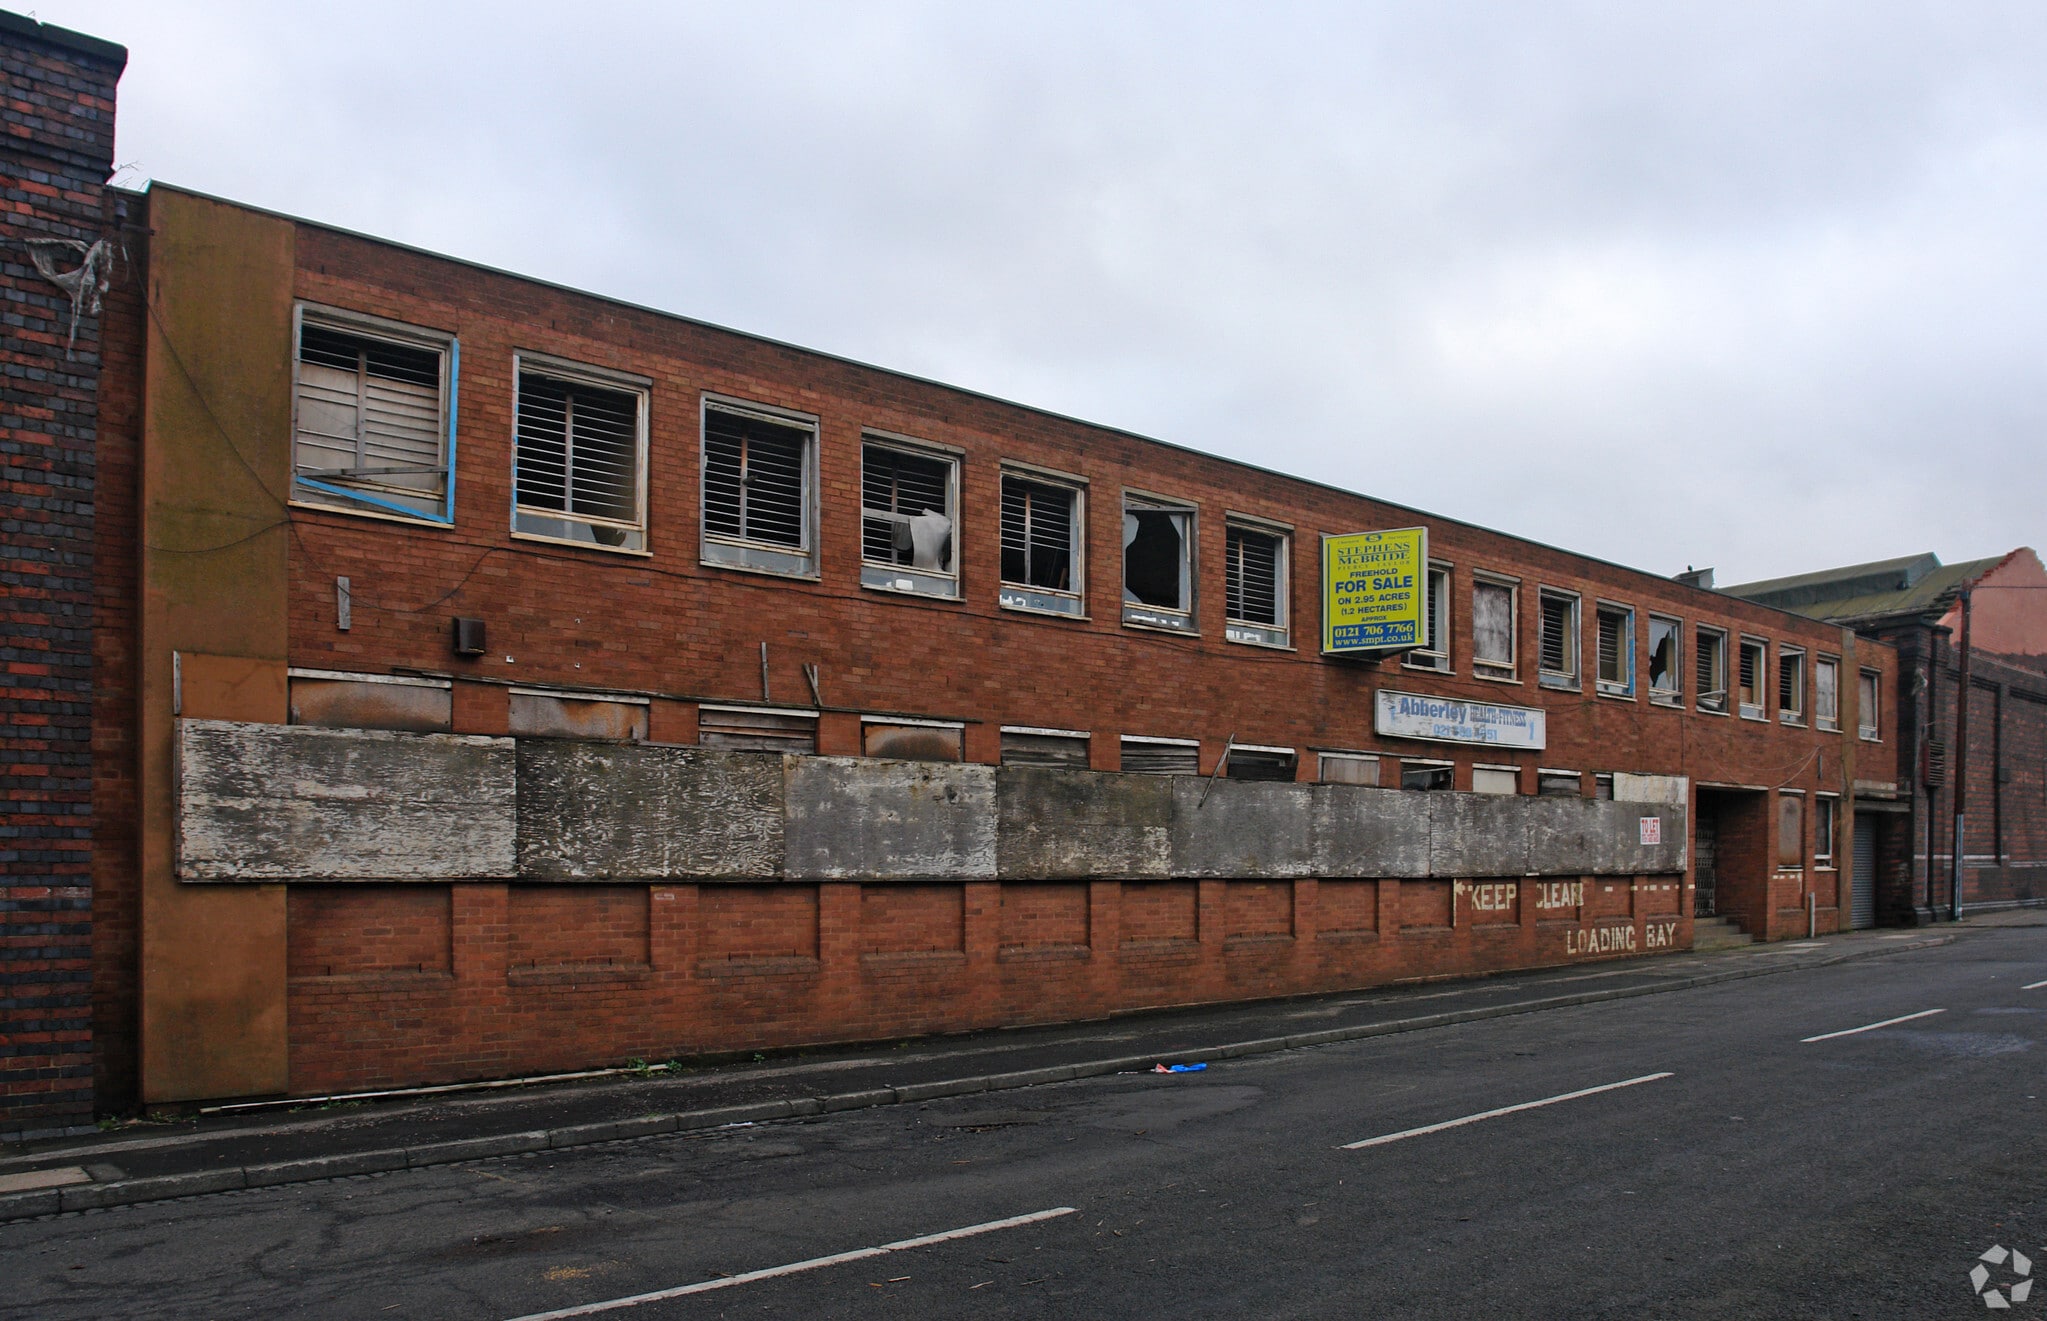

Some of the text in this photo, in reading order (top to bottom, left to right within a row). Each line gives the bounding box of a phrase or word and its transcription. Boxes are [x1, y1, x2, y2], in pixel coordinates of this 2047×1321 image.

[1337, 541, 1411, 556] STEPHENS
[1350, 568, 1398, 578] FREEHOLD
[1335, 575, 1413, 593] FOR SALE
[1337, 592, 1411, 605] ON 2.95 ACRES
[1341, 602, 1408, 616] (1.2 HECTARES)
[1335, 622, 1413, 638] 0121 706 7766
[1335, 632, 1413, 646] www.smpt.co.uk
[1400, 697, 1467, 724] Abberley
[1498, 708, 1527, 728] FITNESS
[1641, 818, 1659, 834] TO LET
[1472, 882, 1585, 911] KEEP CLEAR
[1567, 922, 1676, 955] LOADING BAY
